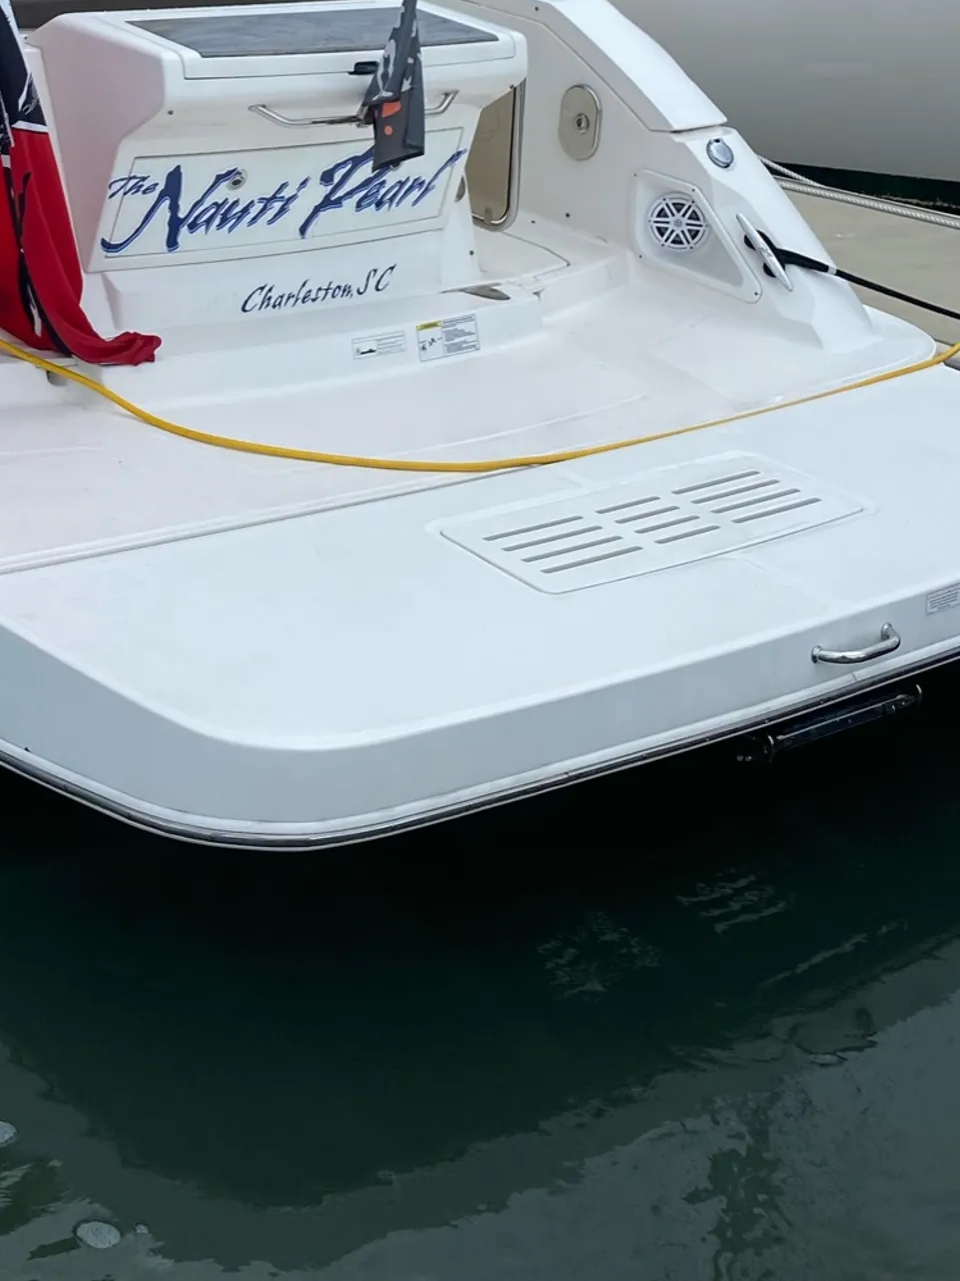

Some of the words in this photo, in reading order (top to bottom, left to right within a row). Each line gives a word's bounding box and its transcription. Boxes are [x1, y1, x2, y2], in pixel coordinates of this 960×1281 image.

[108, 175, 159, 199] The
[299, 144, 467, 239] Pearl
[356, 263, 397, 296] SC
